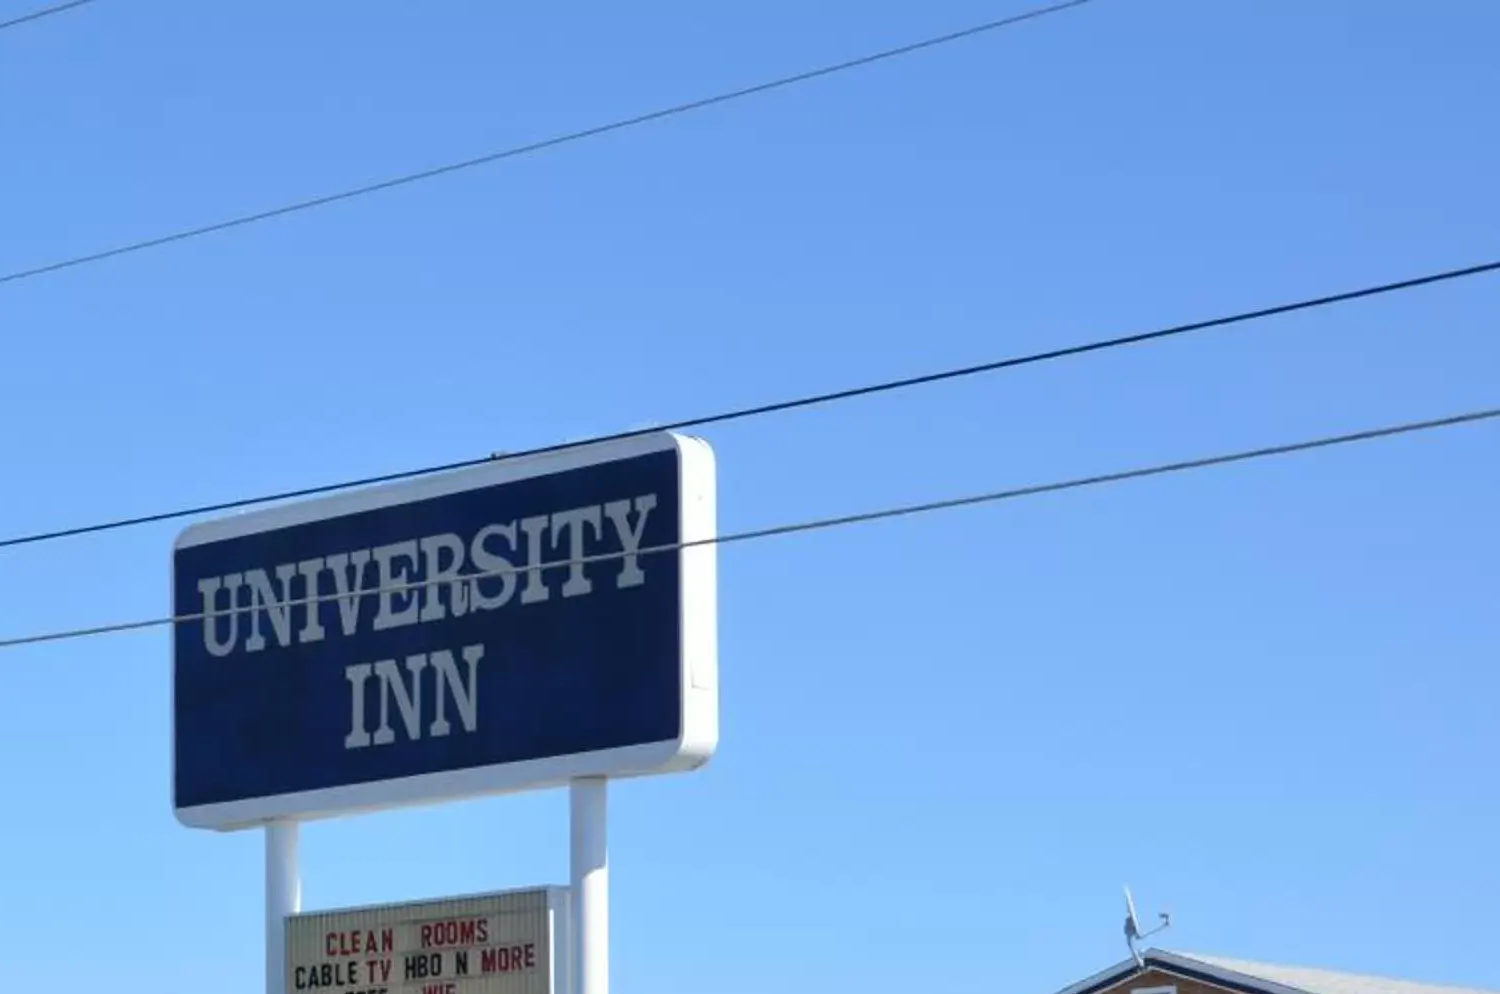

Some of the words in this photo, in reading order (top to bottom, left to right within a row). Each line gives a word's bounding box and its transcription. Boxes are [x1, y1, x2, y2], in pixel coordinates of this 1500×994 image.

[198, 494, 657, 657] UNIVERSITY
[344, 644, 484, 749] INN
[295, 961, 357, 989] CABLE
[366, 959, 392, 984] TV
[405, 953, 442, 980] HBO
[456, 951, 468, 975] N
[482, 944, 535, 972] MORE
[326, 929, 393, 956] CLEAN
[421, 919, 488, 948] ROOMS
